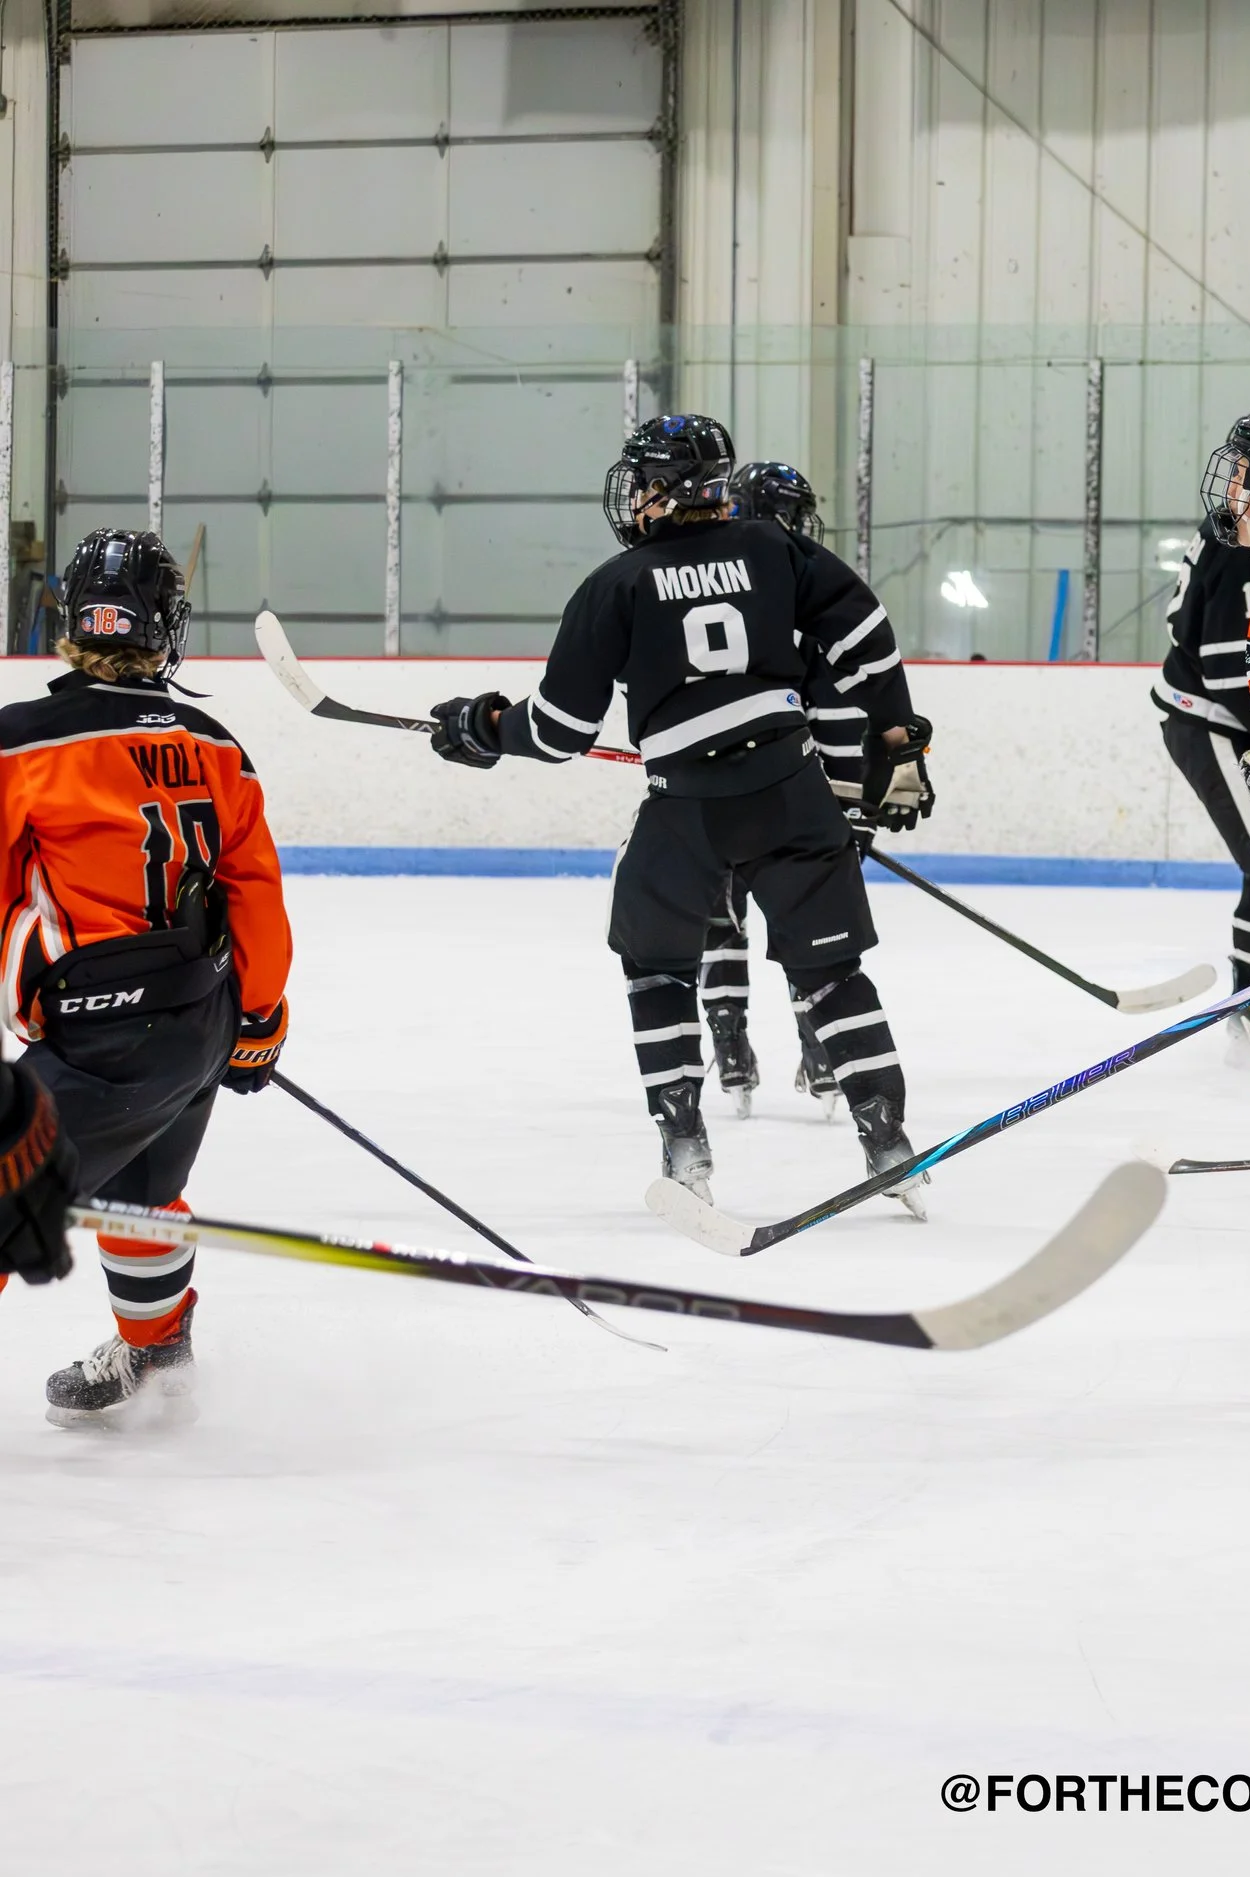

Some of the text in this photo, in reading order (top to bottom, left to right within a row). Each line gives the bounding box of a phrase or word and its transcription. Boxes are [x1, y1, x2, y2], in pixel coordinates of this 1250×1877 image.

[652, 558, 752, 602] MOKIN
[93, 607, 118, 635] 18
[681, 601, 750, 684] 9
[59, 987, 145, 1014] CCM
[1000, 1046, 1136, 1131] BAUER
